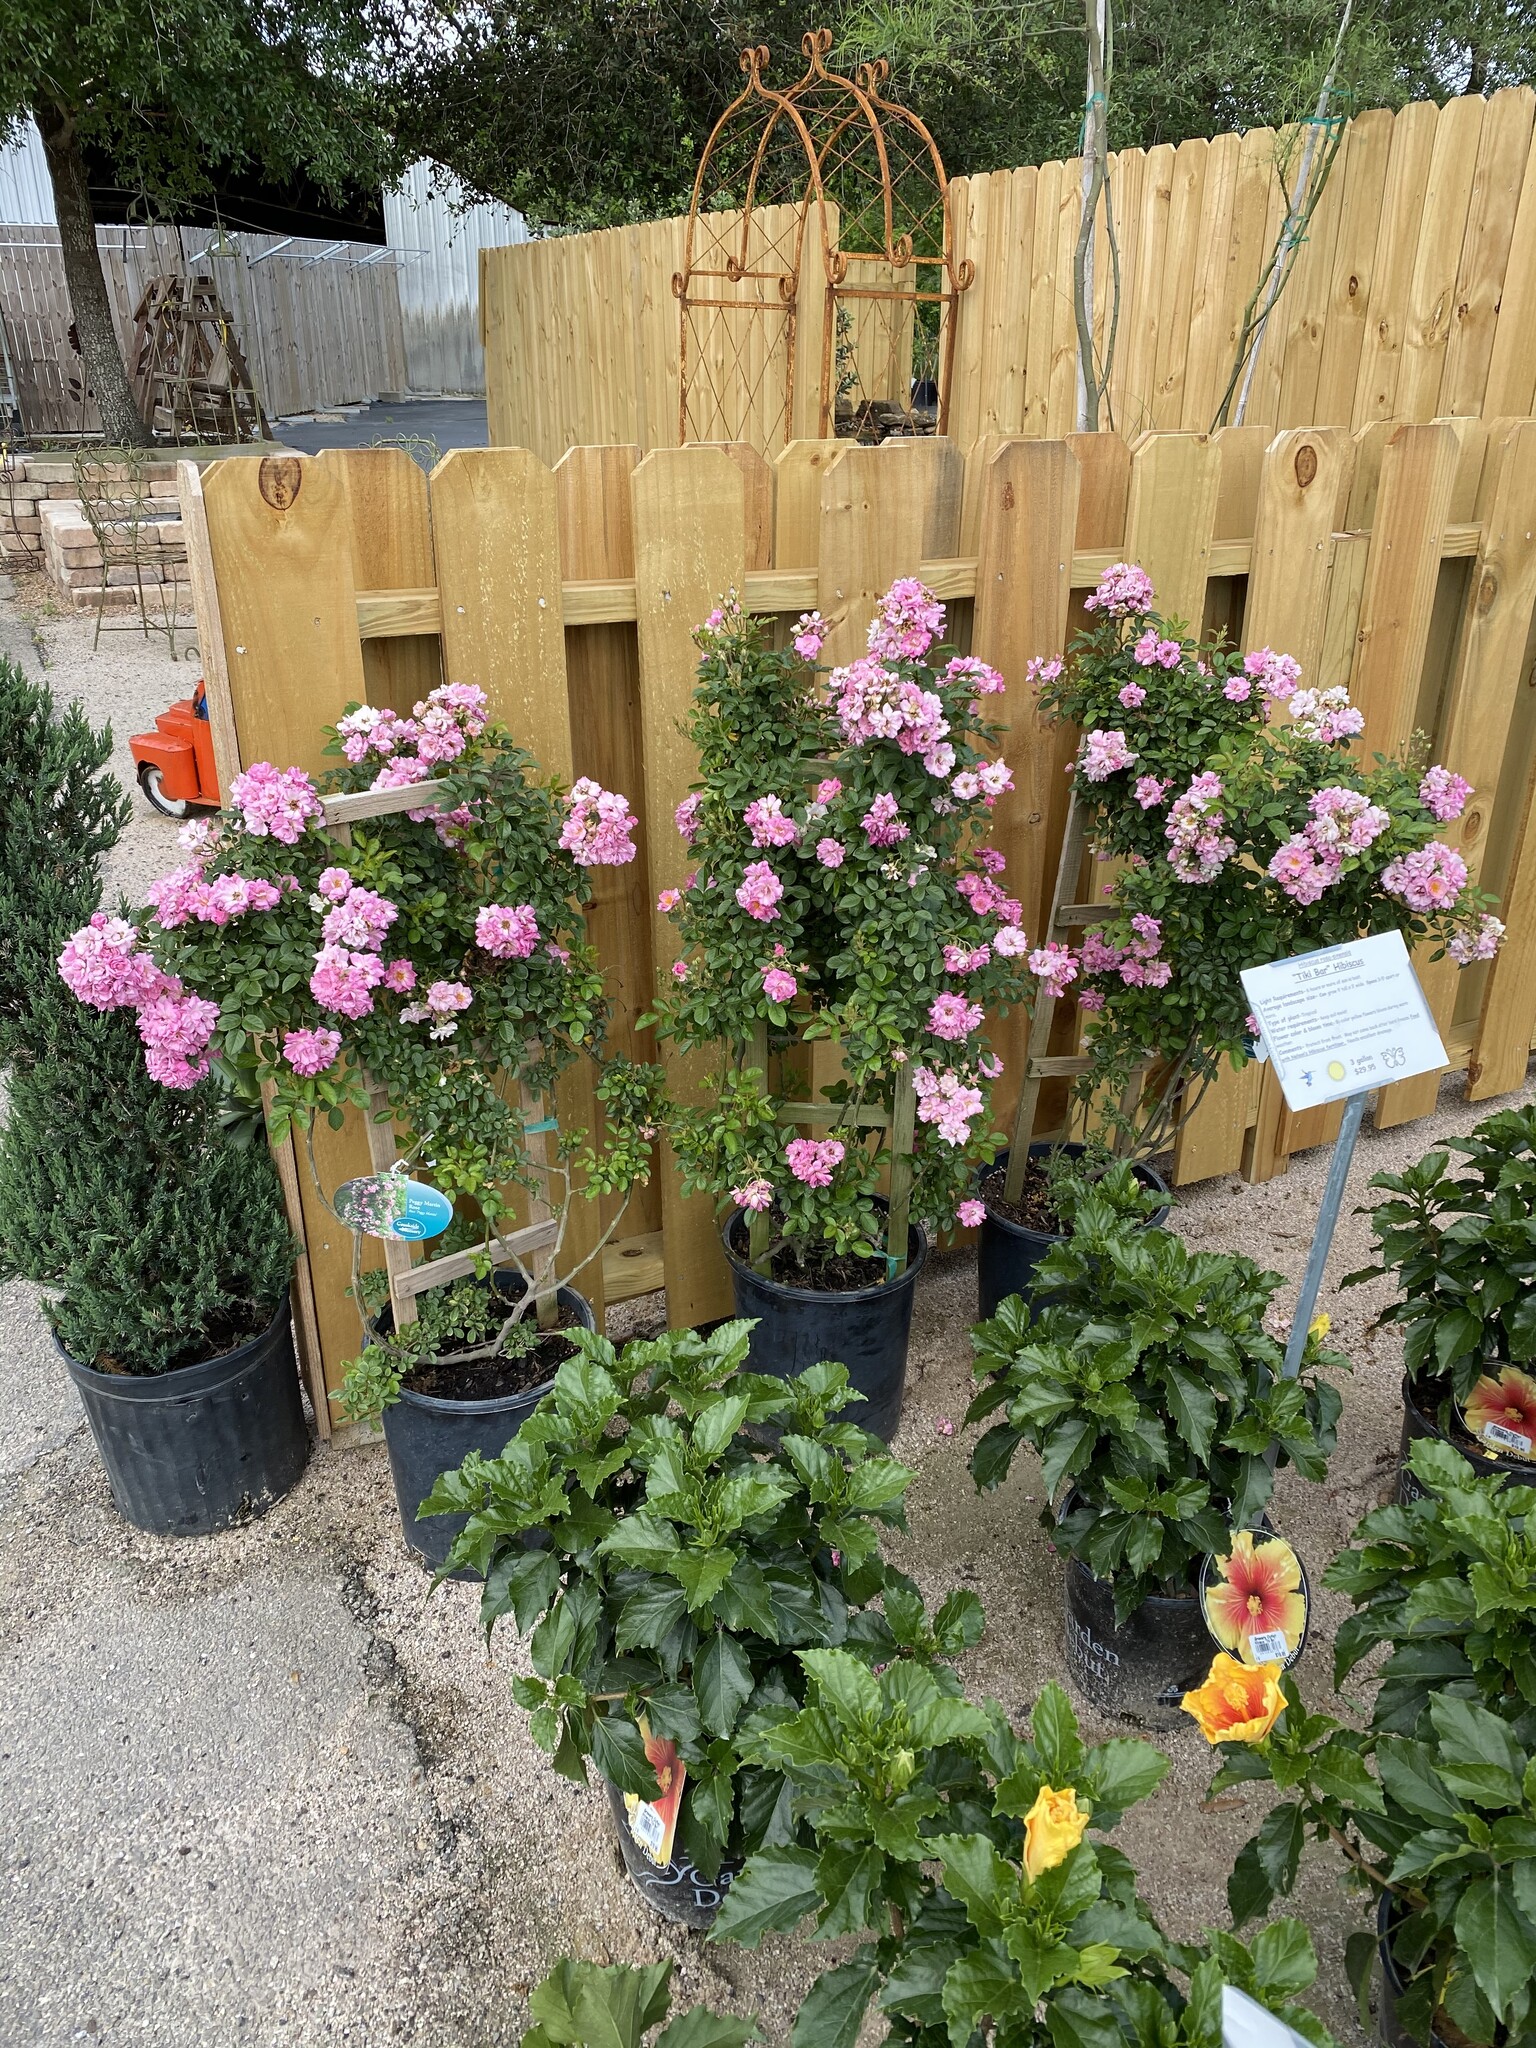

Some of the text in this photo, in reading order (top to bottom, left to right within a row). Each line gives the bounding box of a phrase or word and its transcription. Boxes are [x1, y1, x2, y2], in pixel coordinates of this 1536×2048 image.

[1292, 956, 1365, 983] "Tiki Bar" Hibiscus
[1259, 998, 1273, 1007] Light
[1262, 1004, 1282, 1014] Average
[1268, 1019, 1280, 1028] Type
[1270, 1025, 1287, 1035] Water
[1273, 1033, 1290, 1042] Flower
[1290, 1029, 1303, 1037] color
[1308, 1024, 1322, 1032] bloom
[1356, 1054, 1374, 1065] gallon
[1354, 1063, 1377, 1076] $29.95
[1505, 1450, 1531, 1463] Debut
[1068, 1610, 1121, 1667] arden
